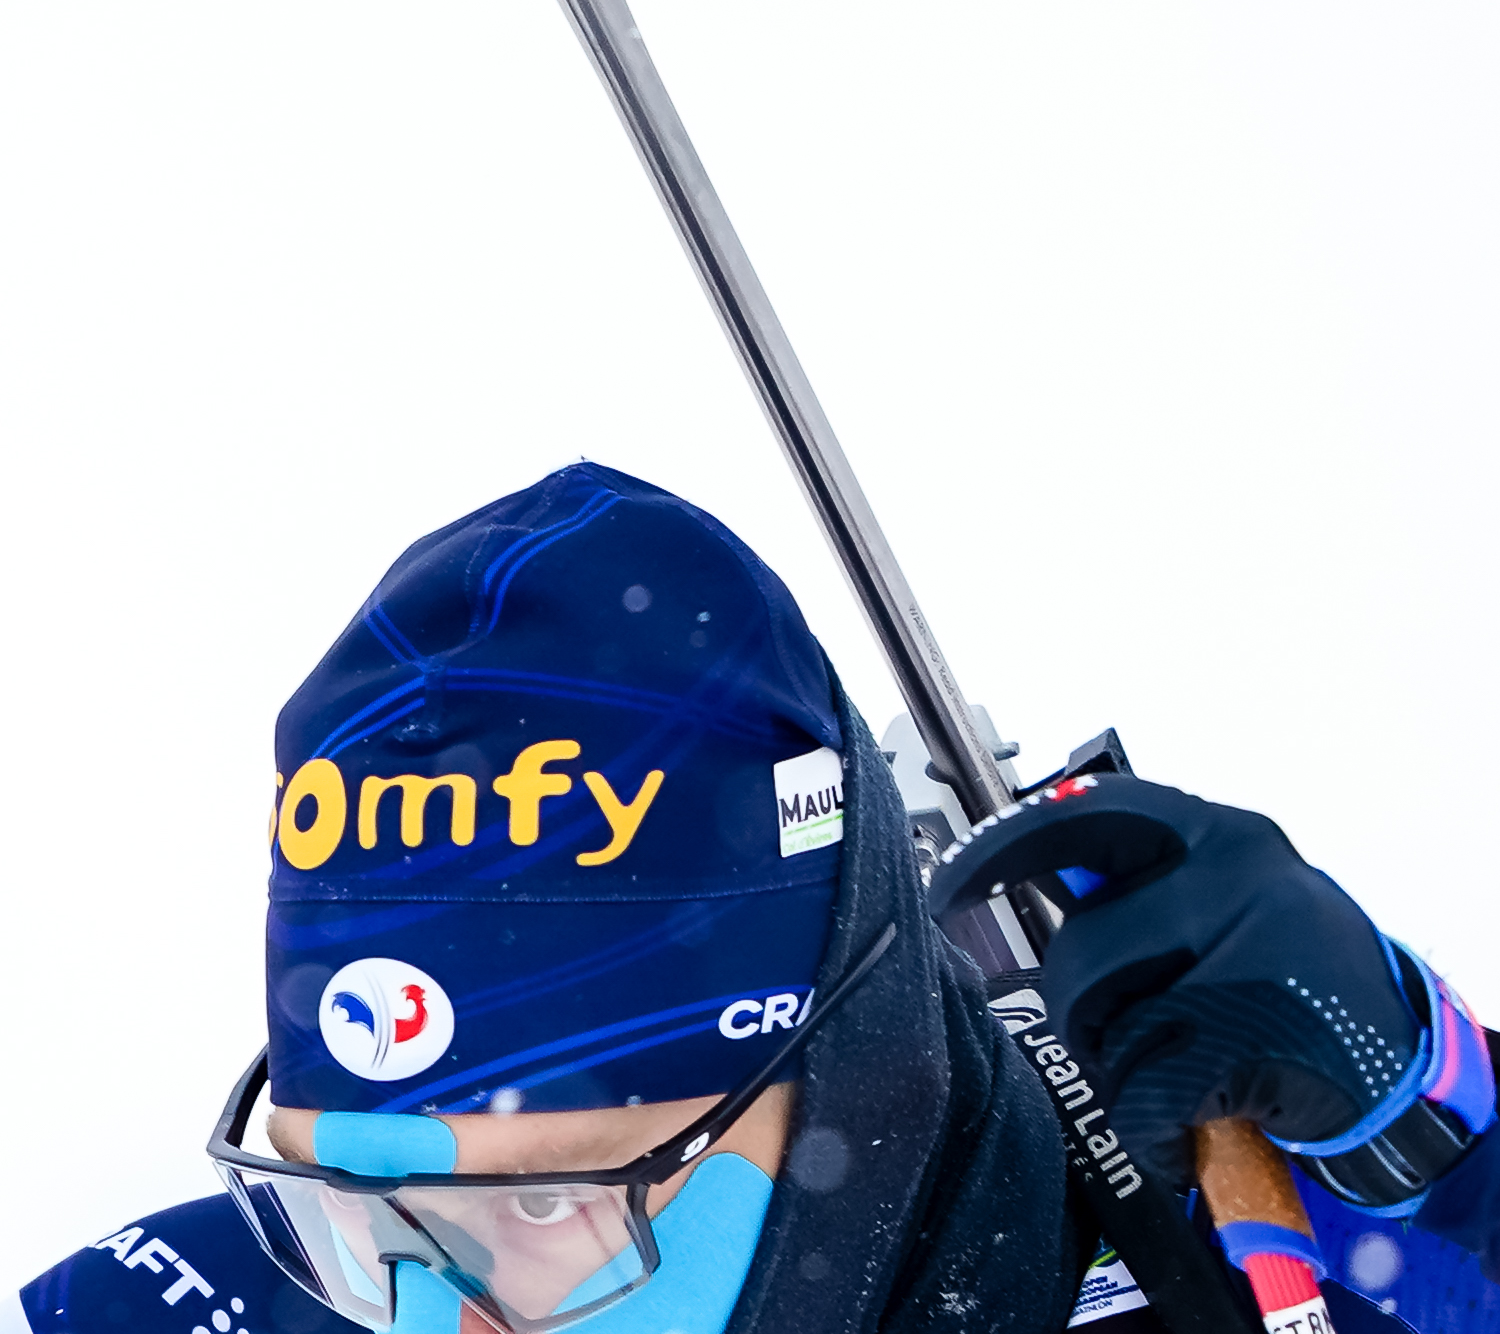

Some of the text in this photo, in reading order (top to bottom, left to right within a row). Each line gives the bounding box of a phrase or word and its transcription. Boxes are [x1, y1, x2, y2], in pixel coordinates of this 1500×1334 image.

[268, 740, 664, 870] omfy
[1023, 1034, 1094, 1111] Jean
[1073, 1108, 1143, 1200] Lain
[87, 1225, 215, 1307] AFT
